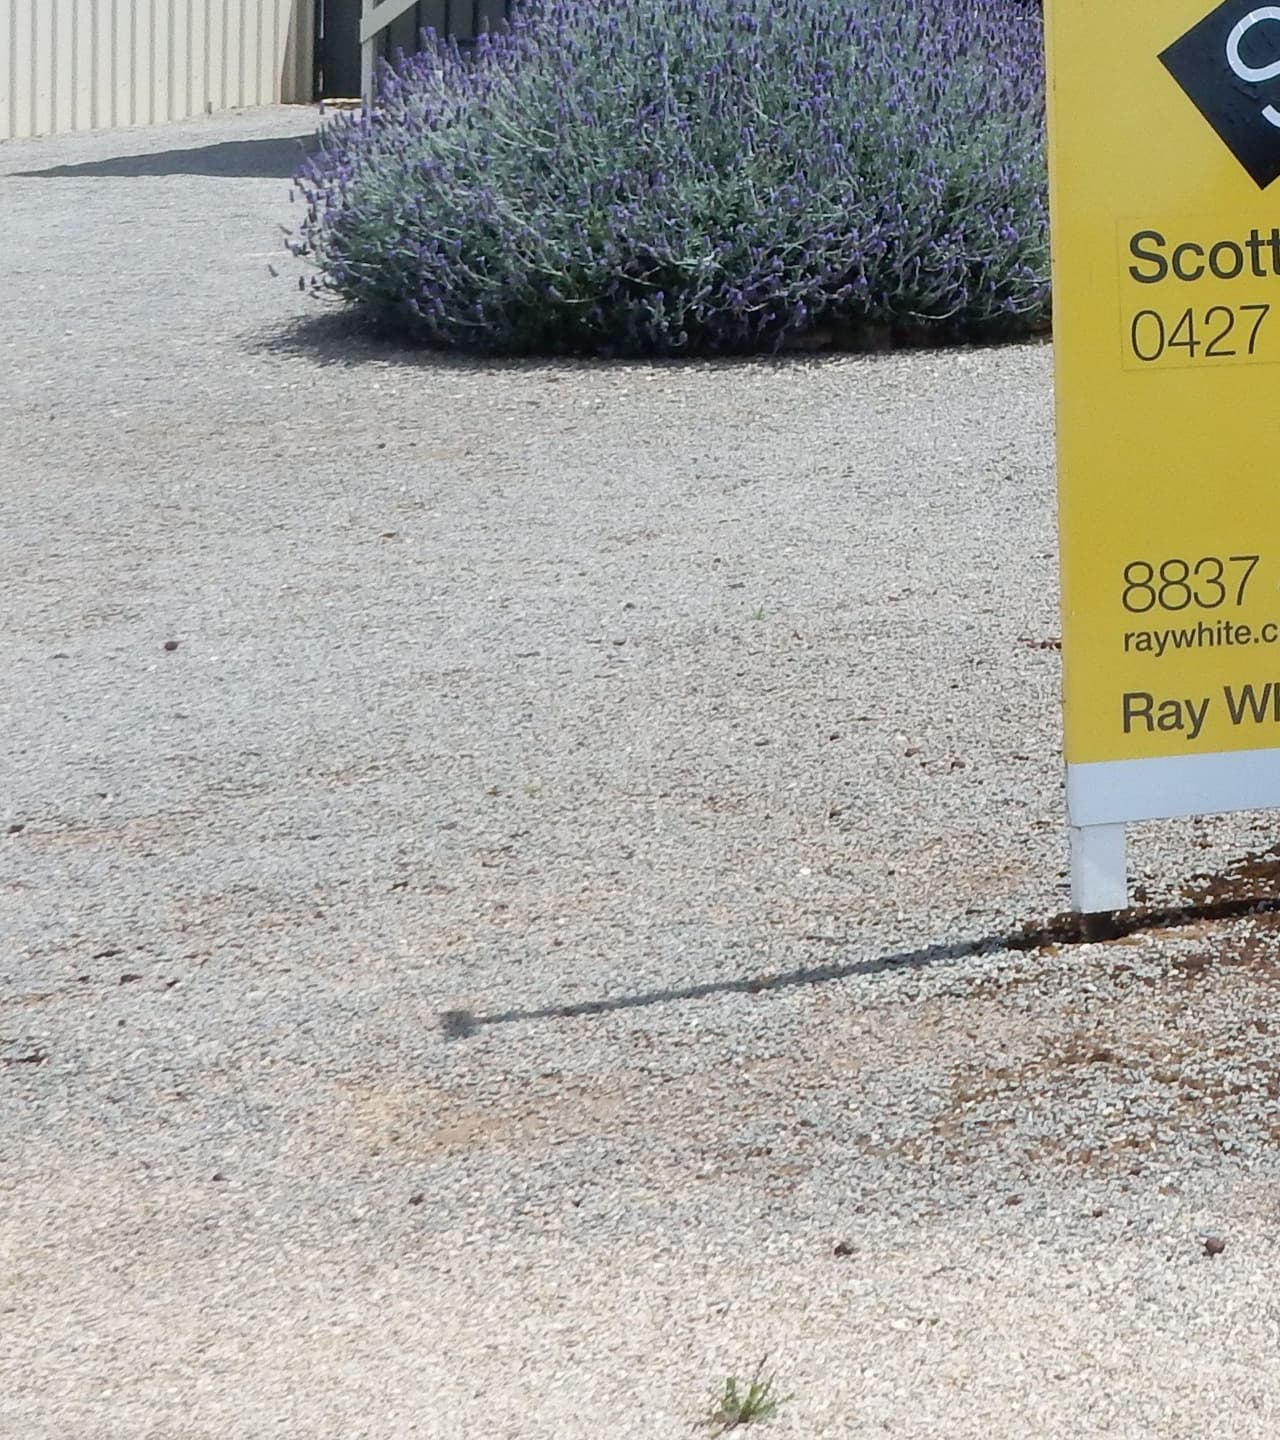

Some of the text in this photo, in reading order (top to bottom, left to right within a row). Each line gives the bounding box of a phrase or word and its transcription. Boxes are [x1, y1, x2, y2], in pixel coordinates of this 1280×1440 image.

[1131, 303, 1271, 362] 0427
[1122, 554, 1260, 614] 8837
[1122, 691, 1211, 741] Ray
